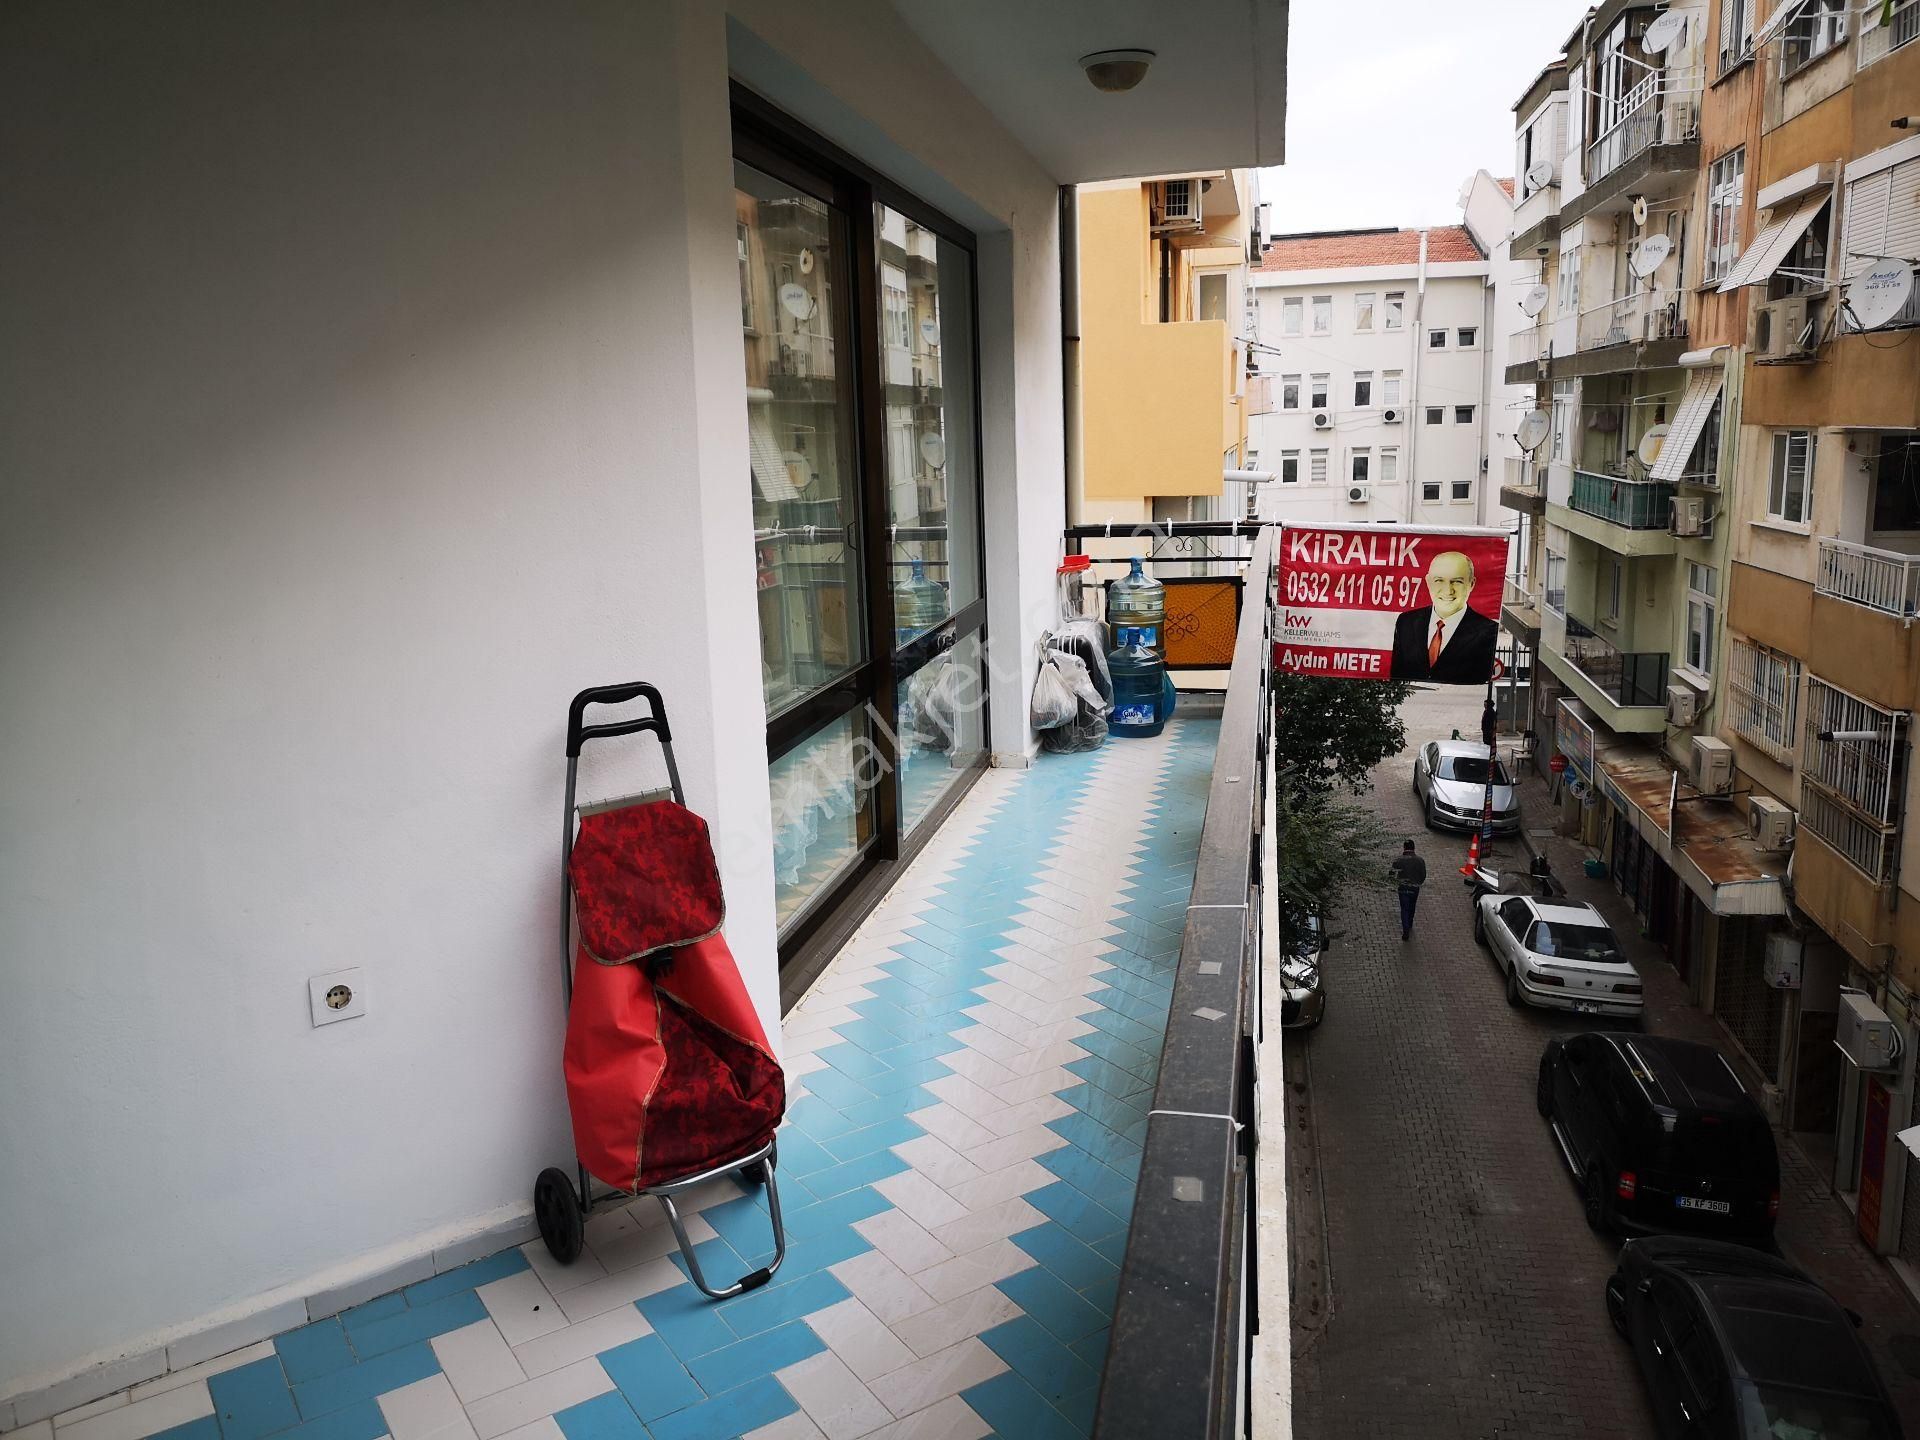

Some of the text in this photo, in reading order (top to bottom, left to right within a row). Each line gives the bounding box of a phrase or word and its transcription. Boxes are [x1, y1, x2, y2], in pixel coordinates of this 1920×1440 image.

[1287, 570, 1422, 608] 0532 411 05 97
[1284, 609, 1312, 628] kw
[1282, 649, 1381, 672] Aydın METE
[1681, 1197, 1692, 1206] 35
[1695, 1199, 1705, 1208] KF
